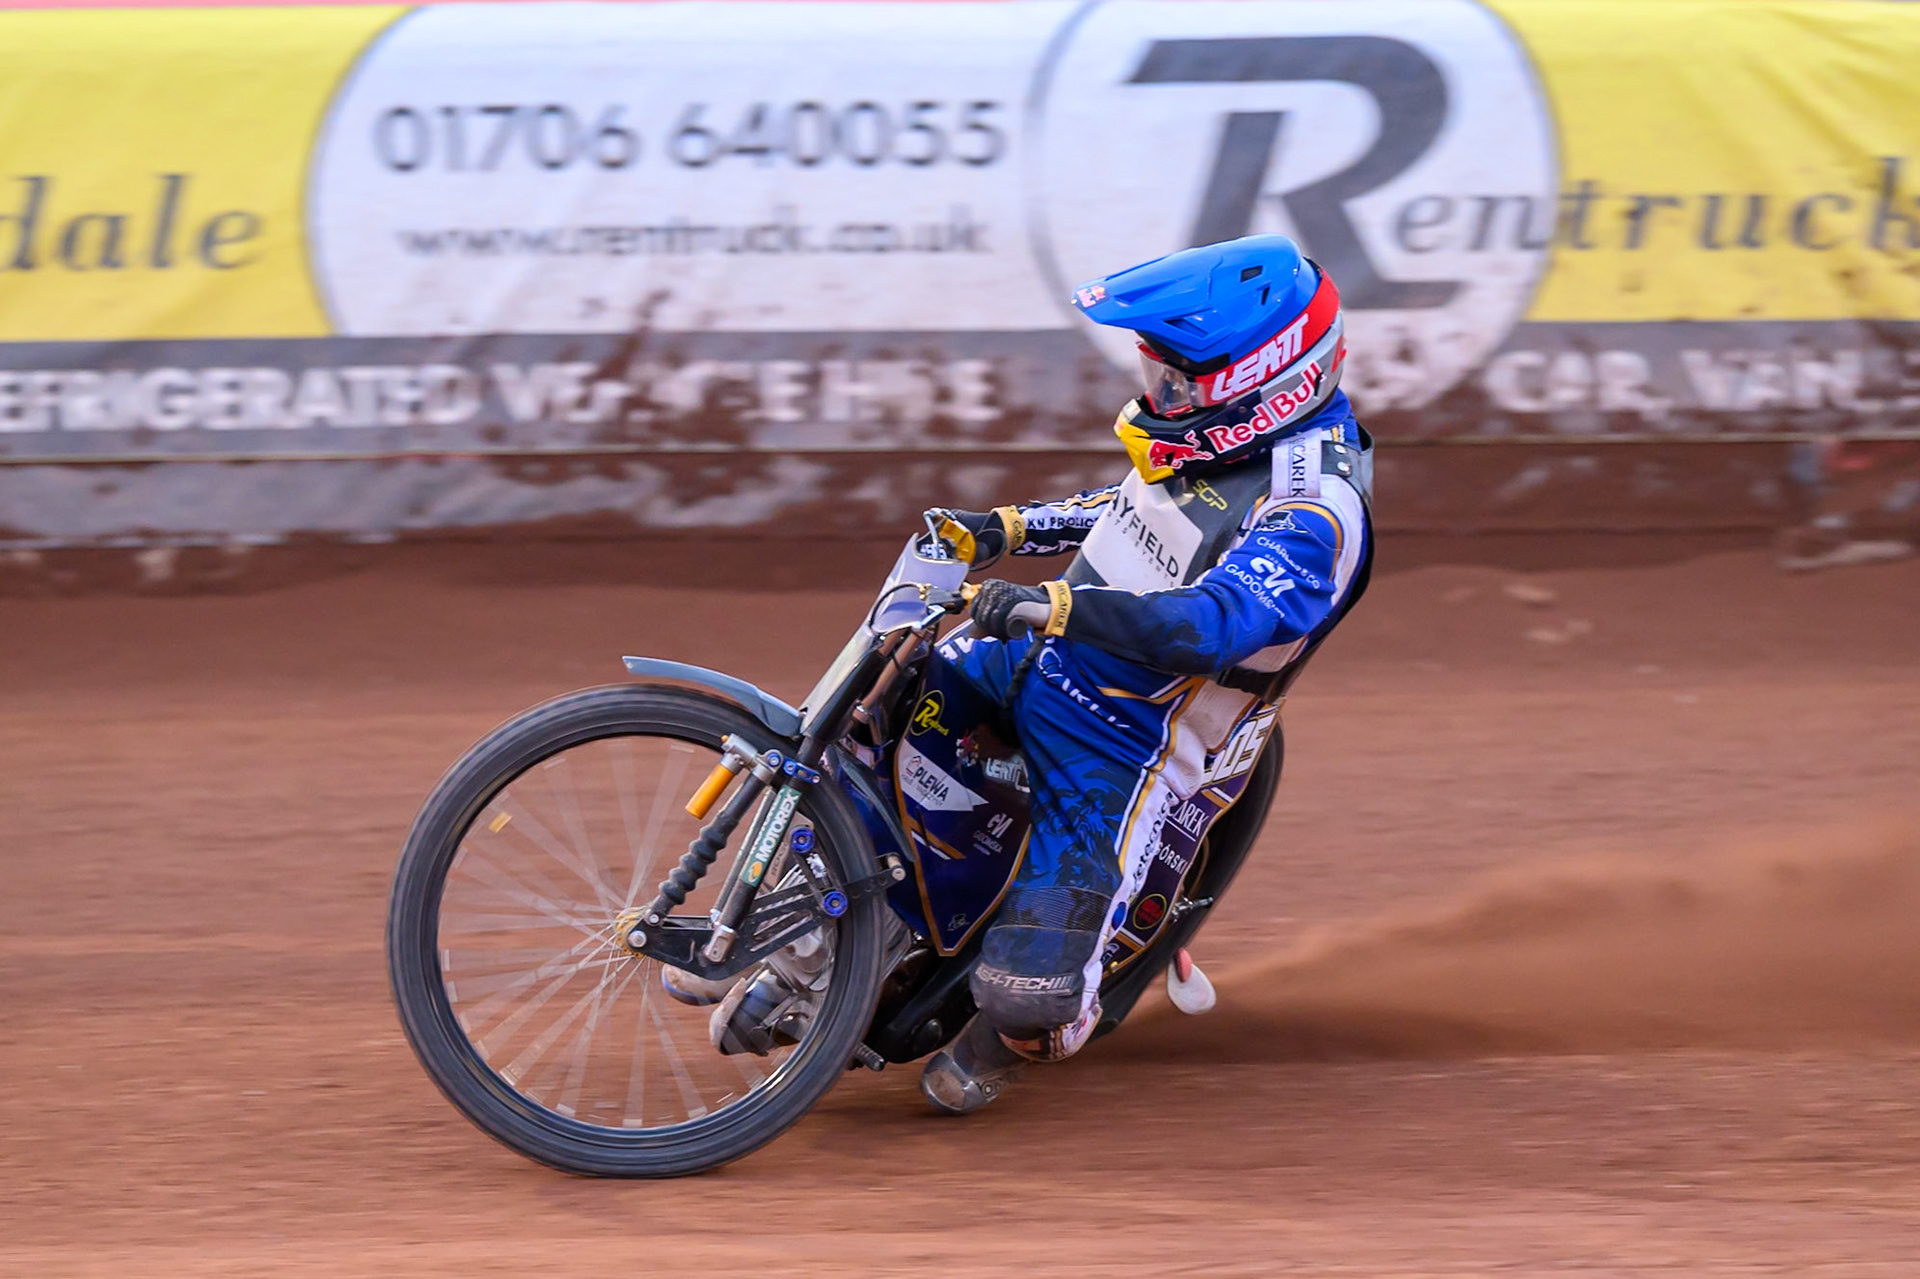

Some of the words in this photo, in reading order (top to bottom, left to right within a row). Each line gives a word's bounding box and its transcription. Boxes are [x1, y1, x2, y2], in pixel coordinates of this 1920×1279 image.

[374, 103, 640, 171] 01706
[668, 100, 1007, 167] 640055
[0, 173, 262, 272] dale
[1203, 404, 1275, 454] Red
[1267, 361, 1326, 421] Bull
[913, 766, 949, 802] PLEWA
[755, 788, 799, 862] MOTOREX
